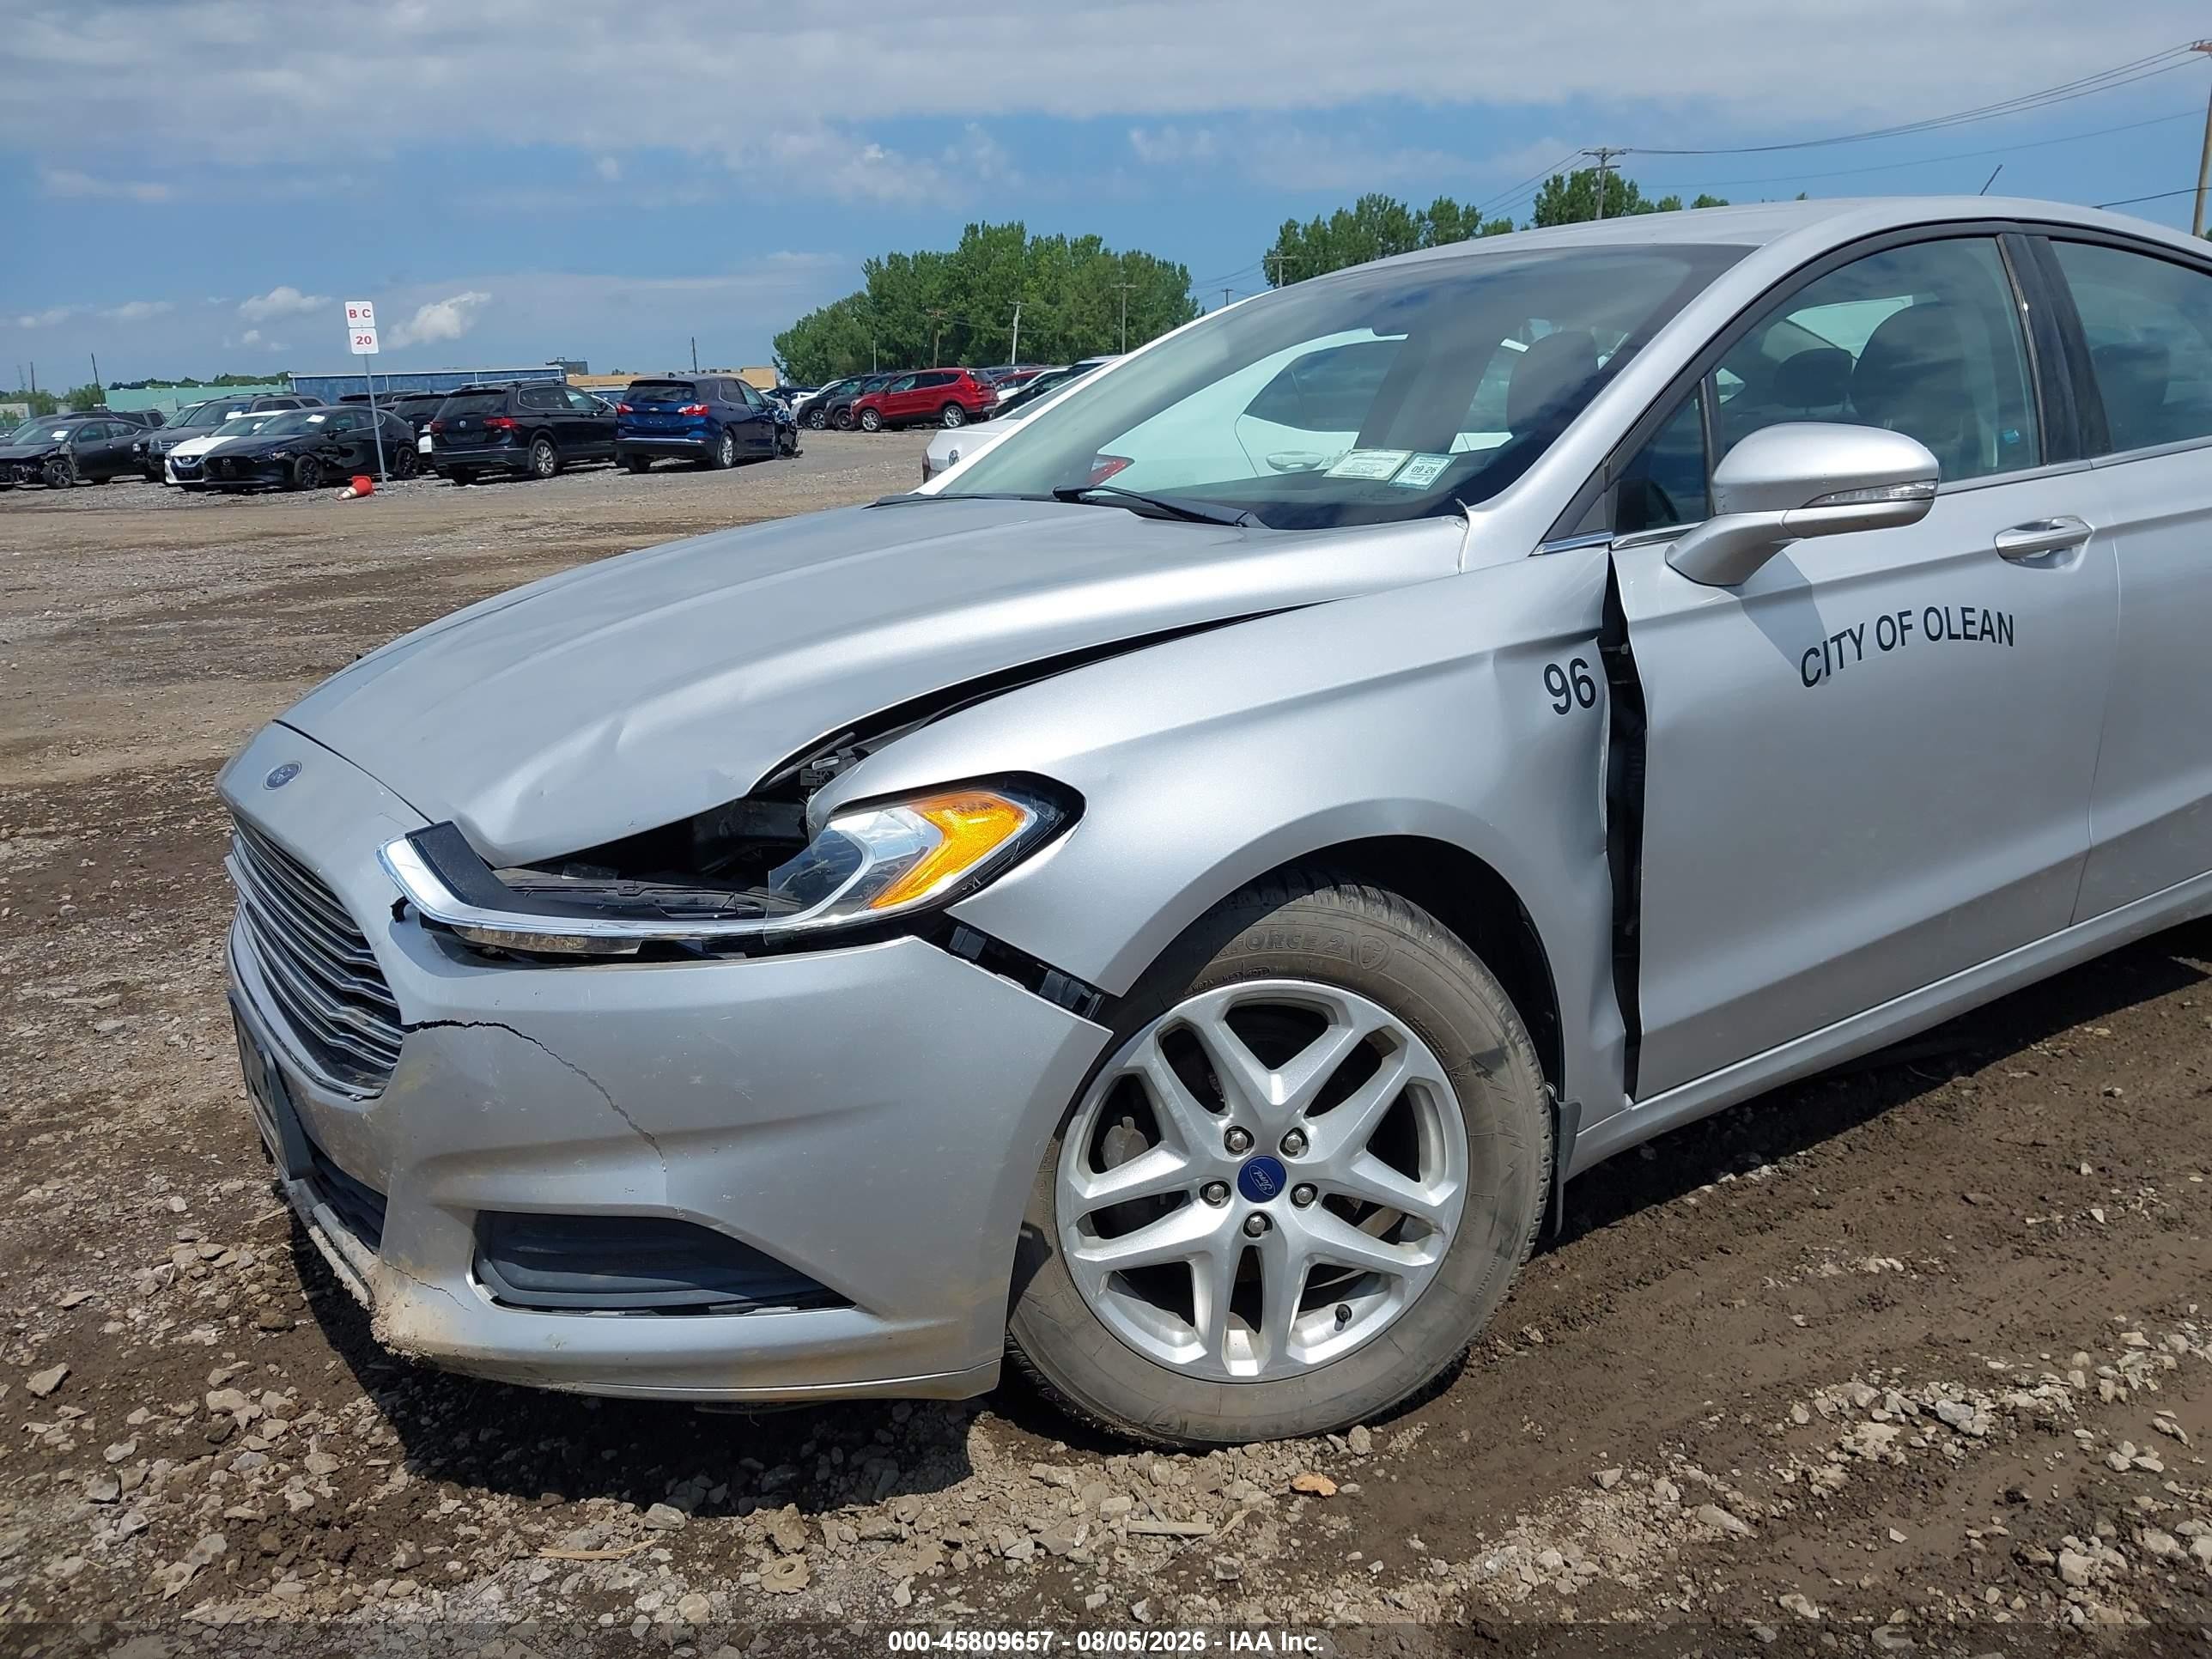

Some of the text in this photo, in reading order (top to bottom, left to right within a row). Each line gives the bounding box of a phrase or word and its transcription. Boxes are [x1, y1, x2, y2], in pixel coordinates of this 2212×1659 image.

[349, 308, 371, 319] B C
[356, 336, 372, 345] 20
[1801, 605, 2014, 688] CITY OF OLEAN
[1543, 658, 1596, 715] 96
